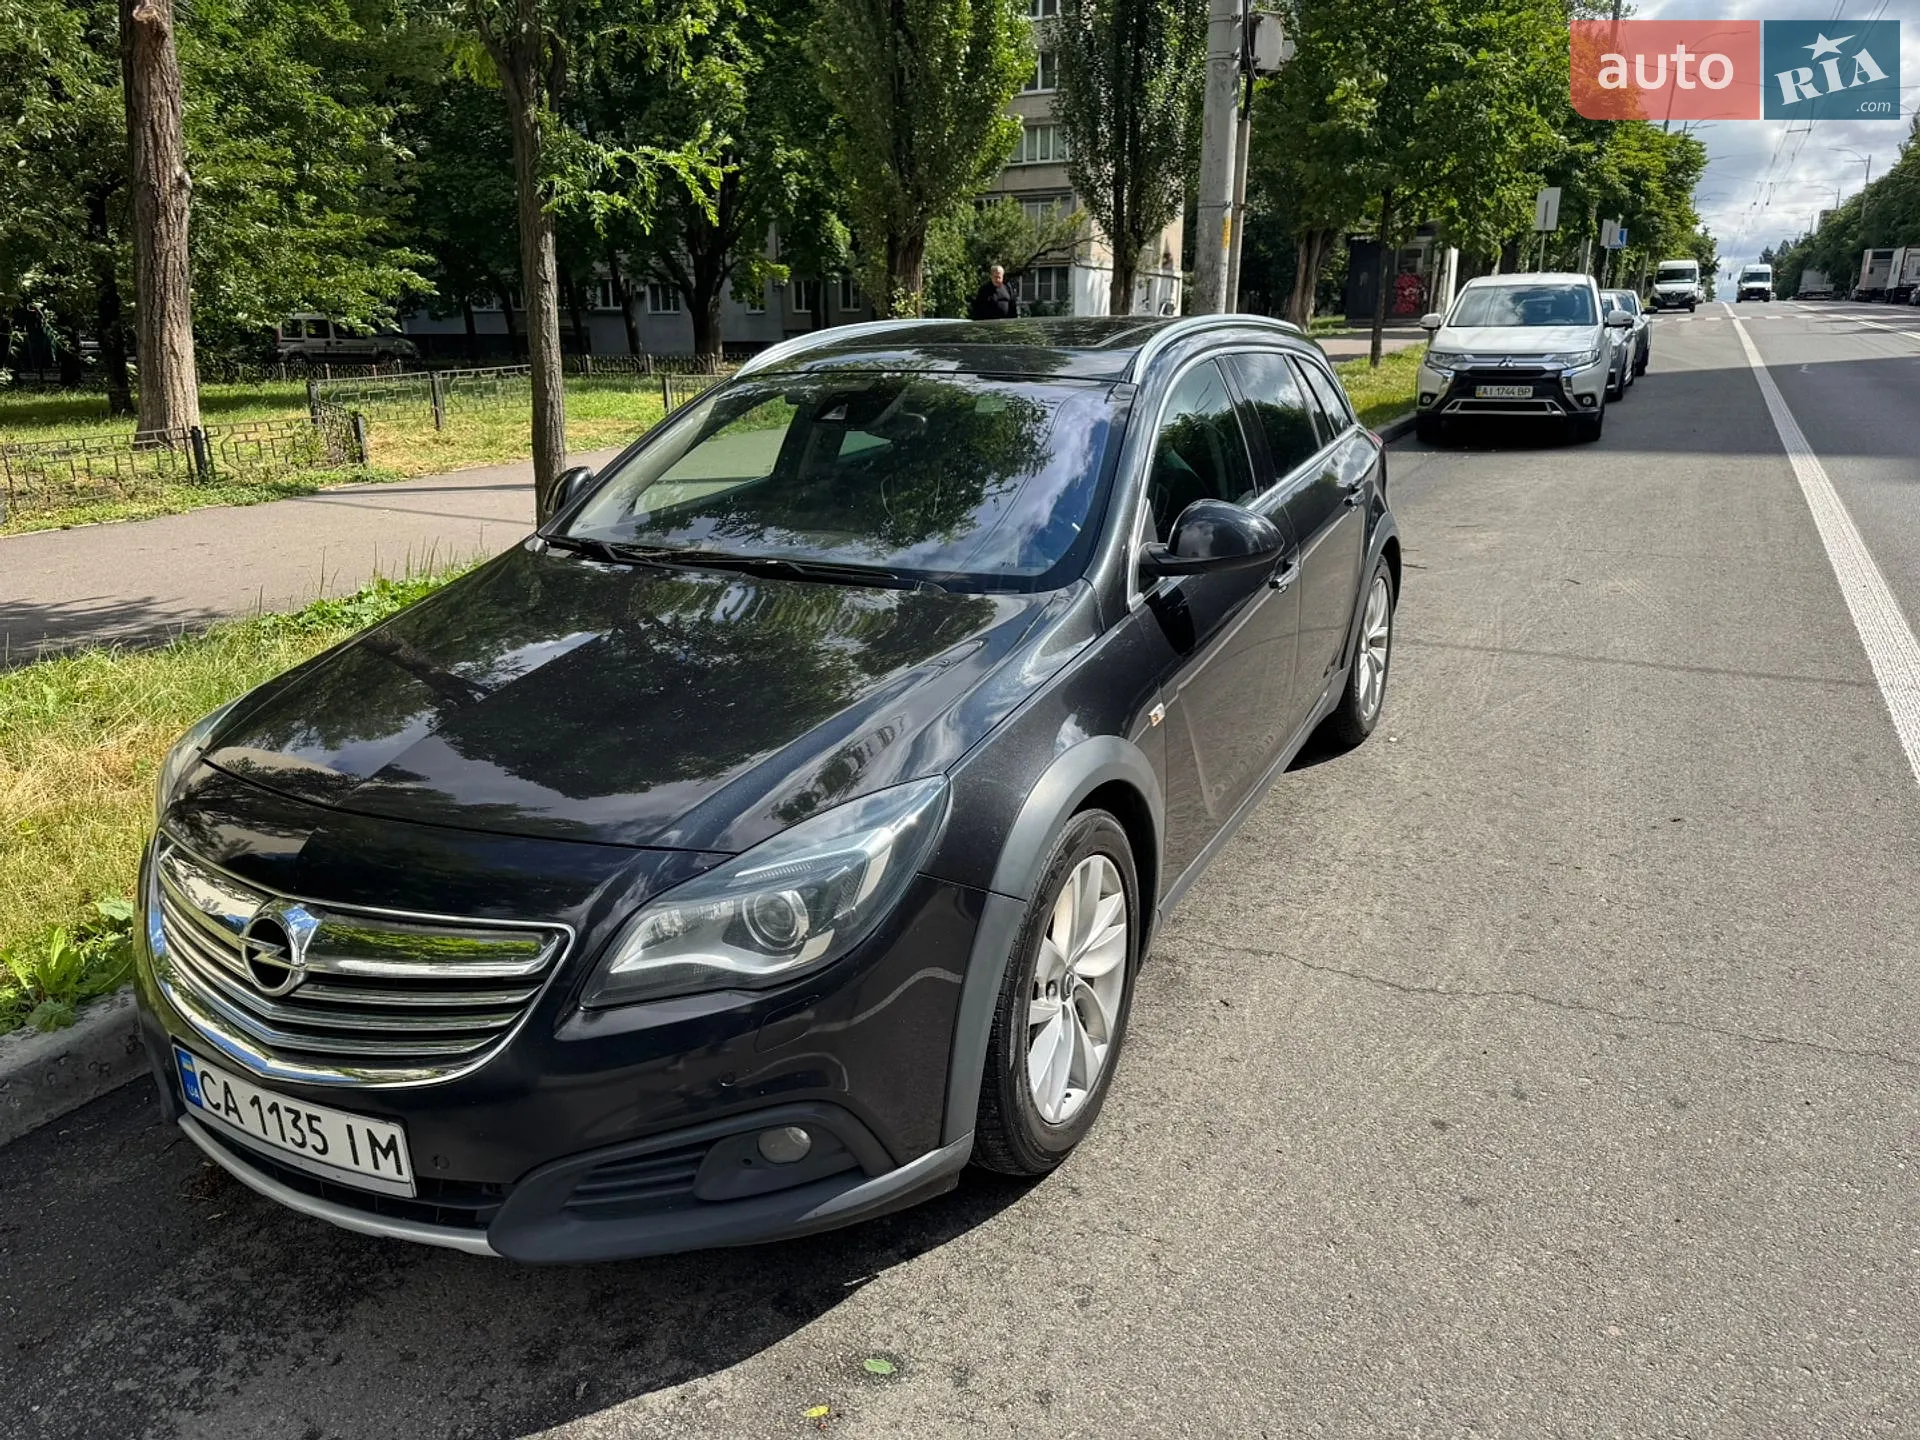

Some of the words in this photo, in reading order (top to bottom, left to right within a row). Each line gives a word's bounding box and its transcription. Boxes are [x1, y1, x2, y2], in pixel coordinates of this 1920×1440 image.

[199, 1070, 244, 1125] CA
[249, 1094, 329, 1156] 1135
[346, 1123, 403, 1176] IM
